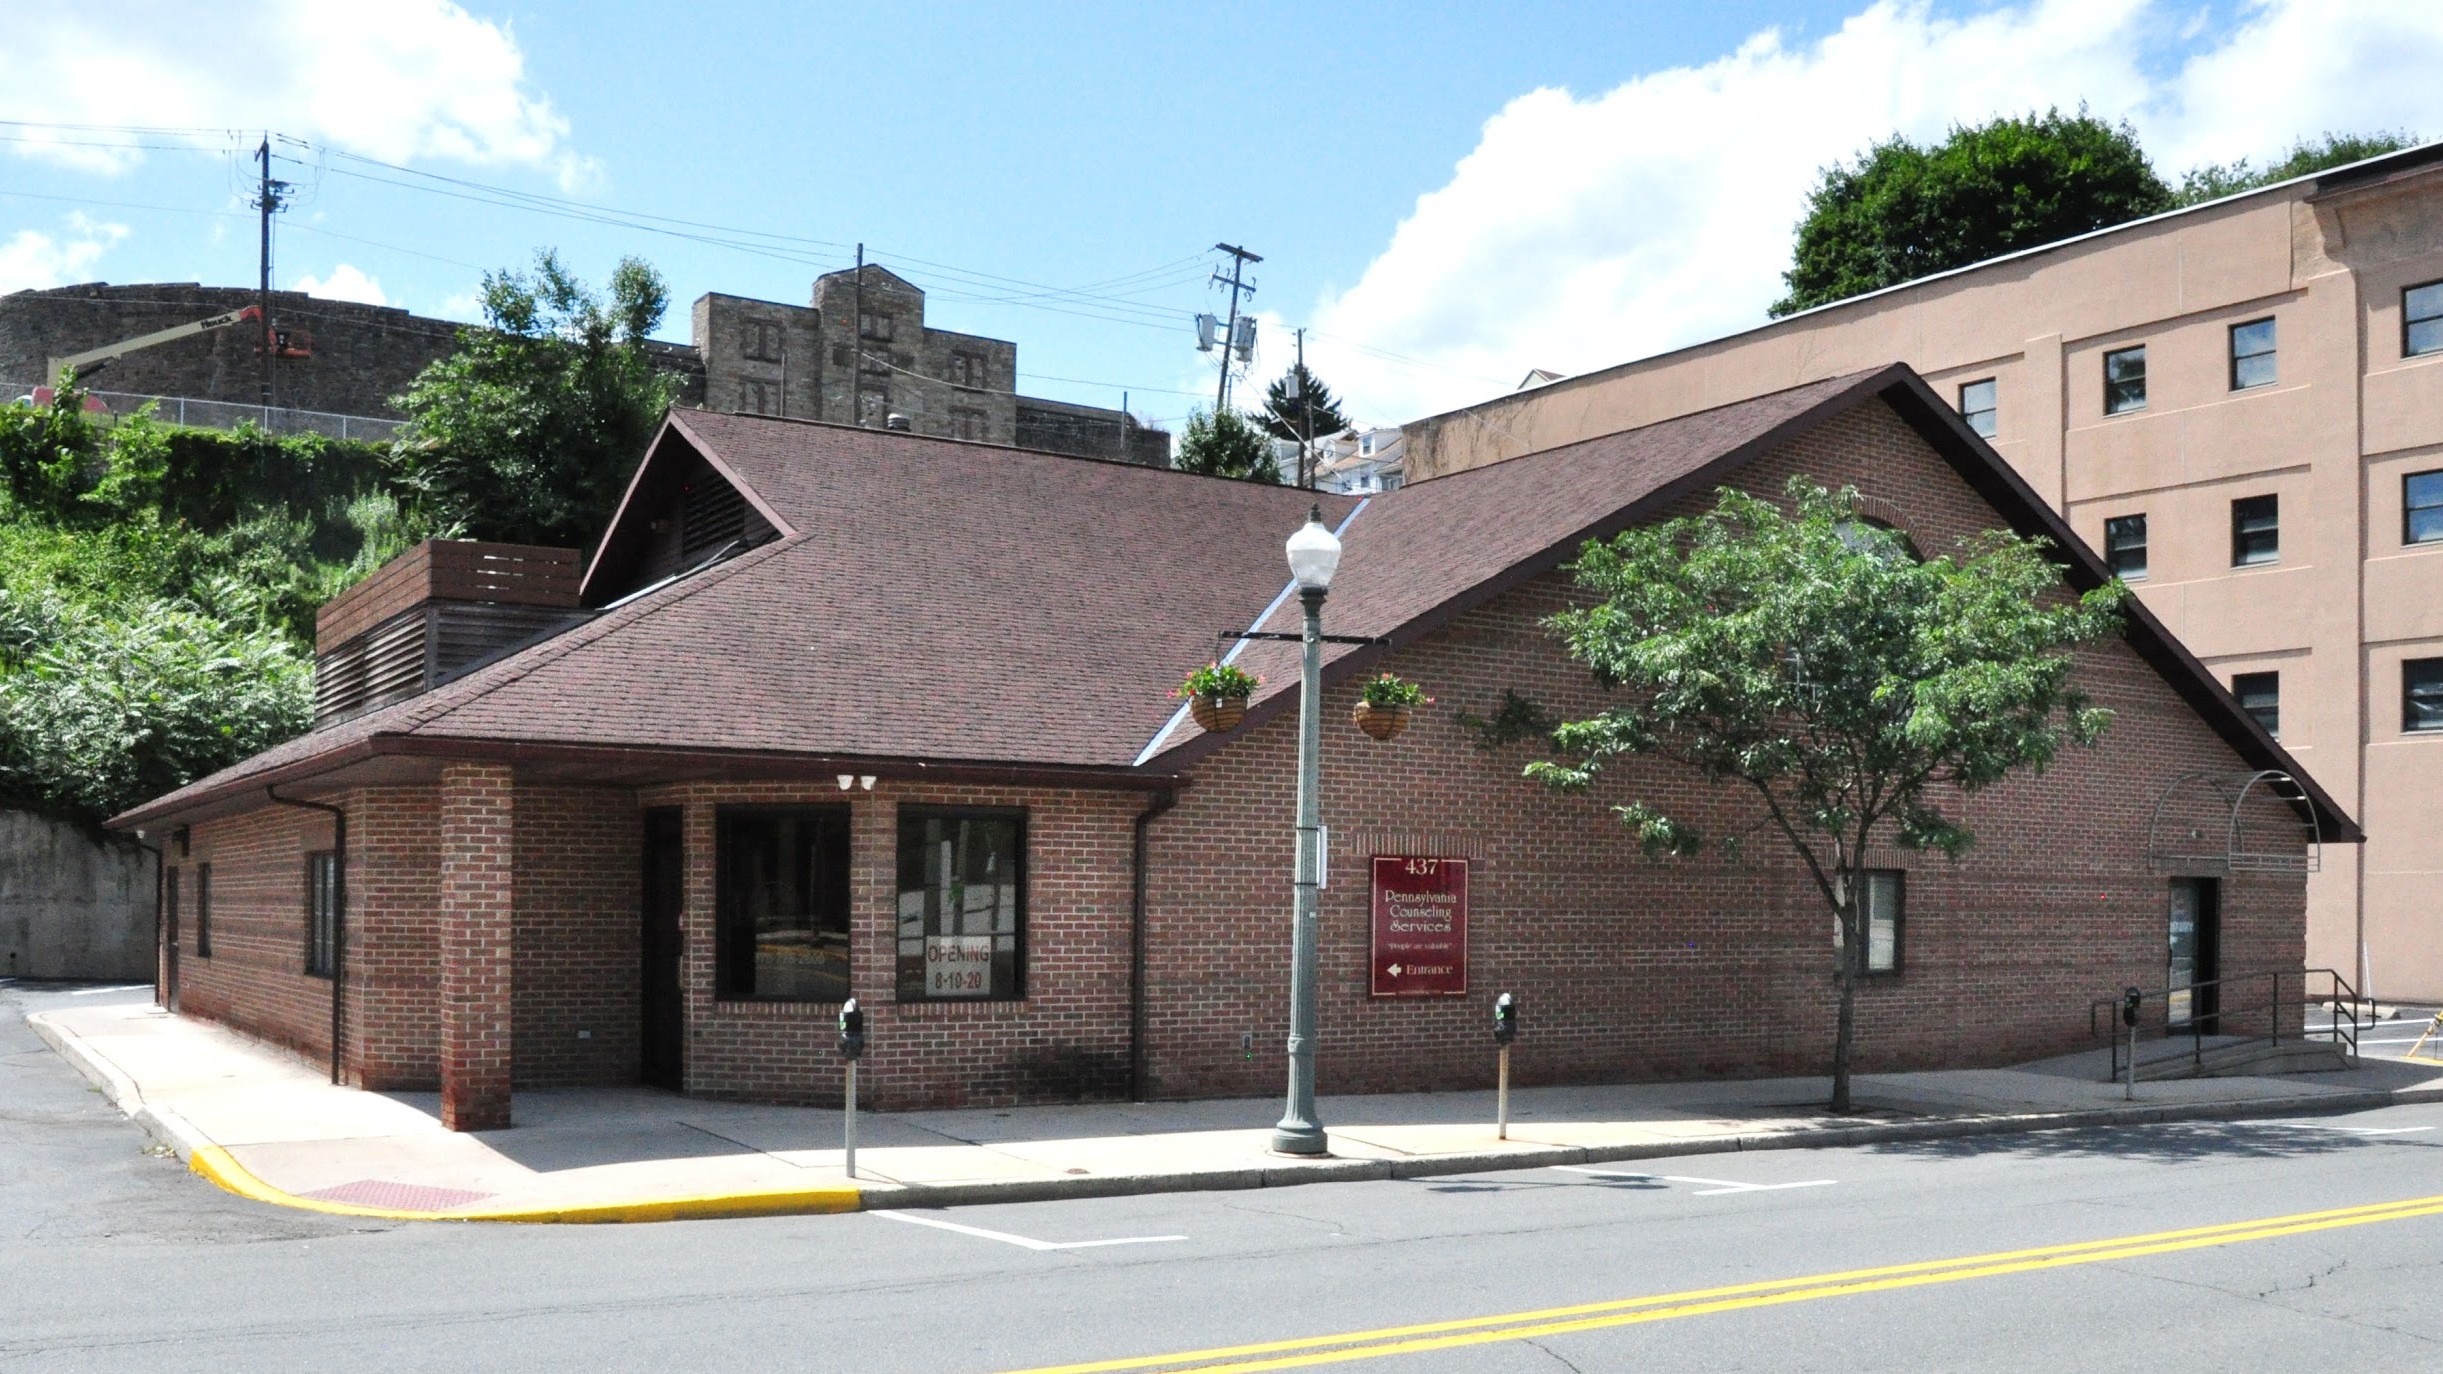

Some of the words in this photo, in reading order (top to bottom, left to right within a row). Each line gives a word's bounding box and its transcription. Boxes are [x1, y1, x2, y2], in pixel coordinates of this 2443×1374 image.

[1405, 858, 1439, 875] 437
[1385, 889, 1457, 907] Pennsylvania
[1389, 905, 1452, 922] Counseling
[1389, 920, 1452, 933] Services
[928, 944, 989, 962] OPENING
[1406, 964, 1454, 975] Entrance
[935, 972, 982, 989] 8-10-20
